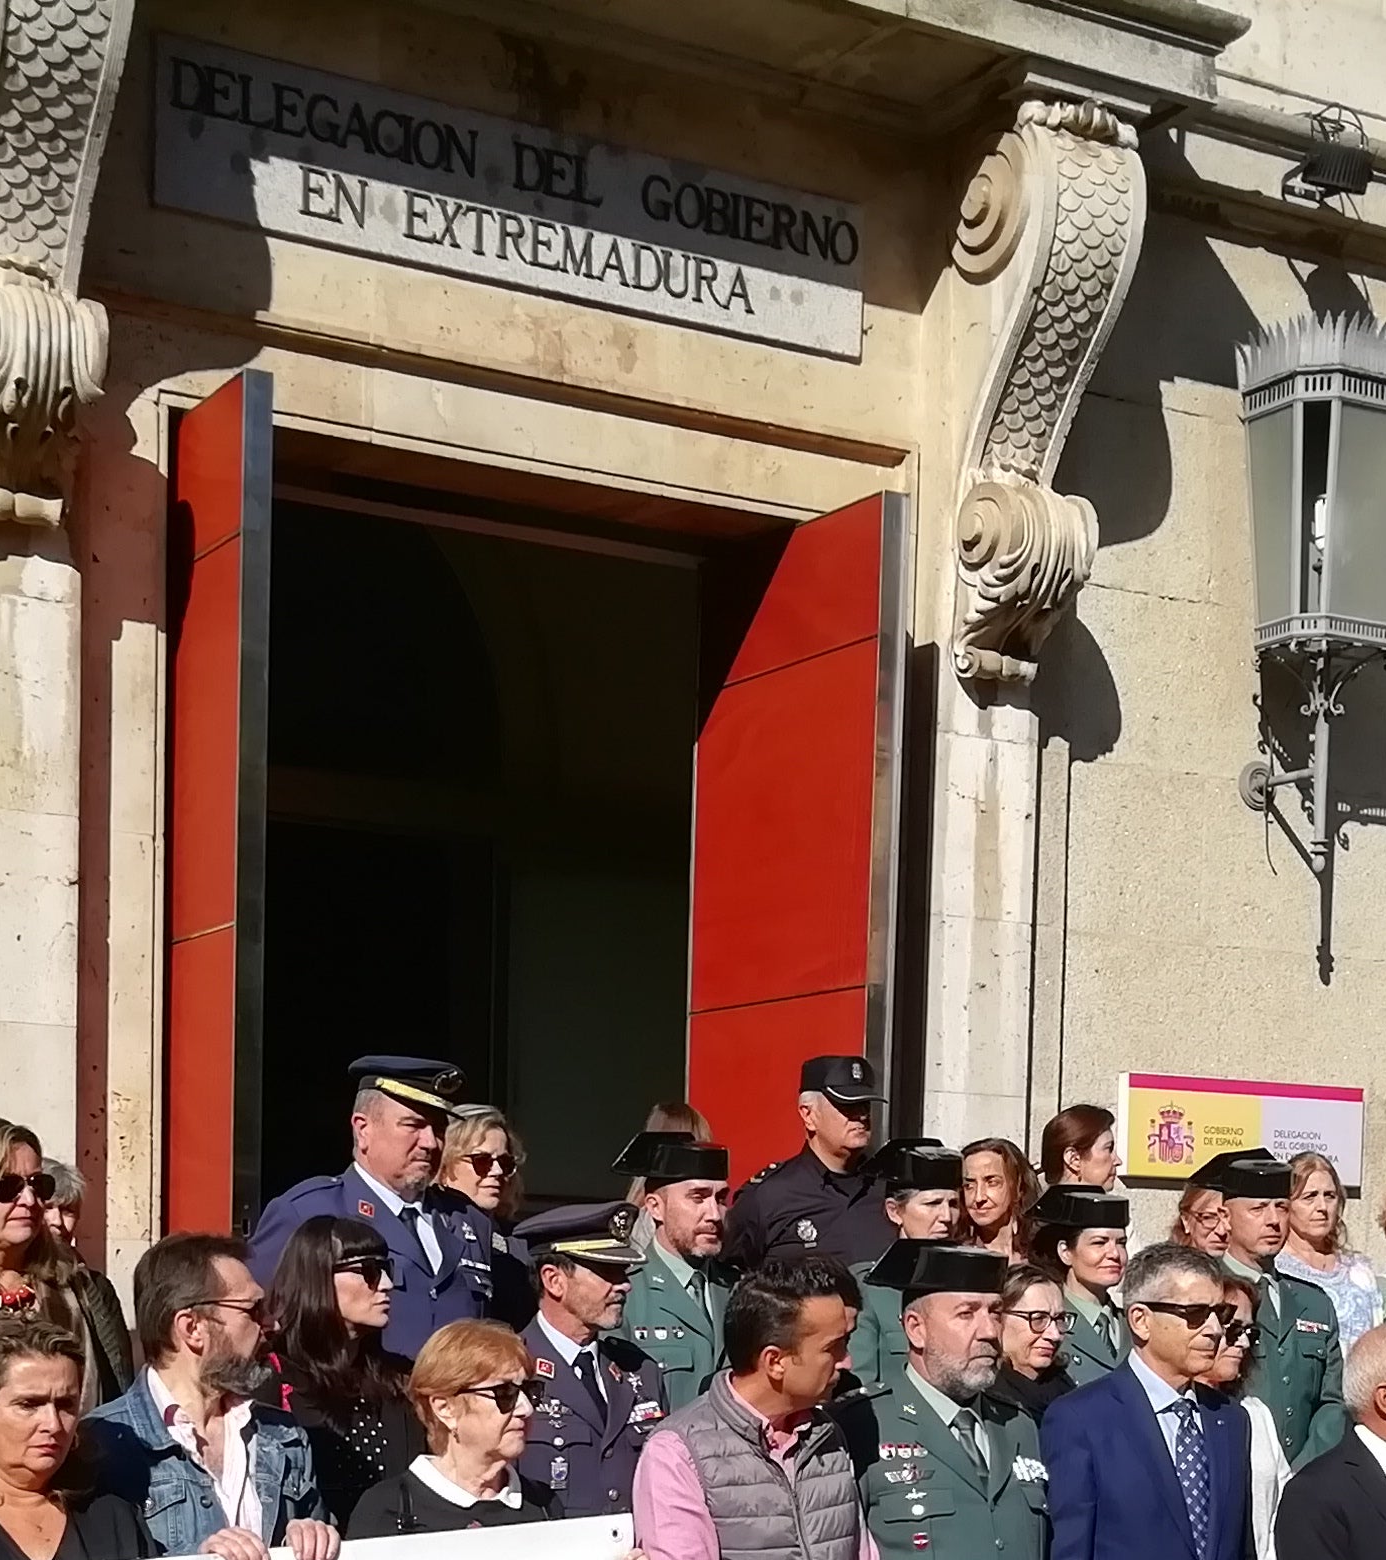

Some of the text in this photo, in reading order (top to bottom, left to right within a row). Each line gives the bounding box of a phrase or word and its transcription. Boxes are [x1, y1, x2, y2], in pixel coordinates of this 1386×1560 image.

[169, 55, 859, 266] DELEGACION DEL GOBIERNO
[298, 165, 755, 315] EN EXTREMADURA
[1203, 1126, 1244, 1136] GOBIERNO
[1203, 1136, 1244, 1147] DE ESPAÑA
[1273, 1140, 1328, 1152] DEL GOBIERNO
